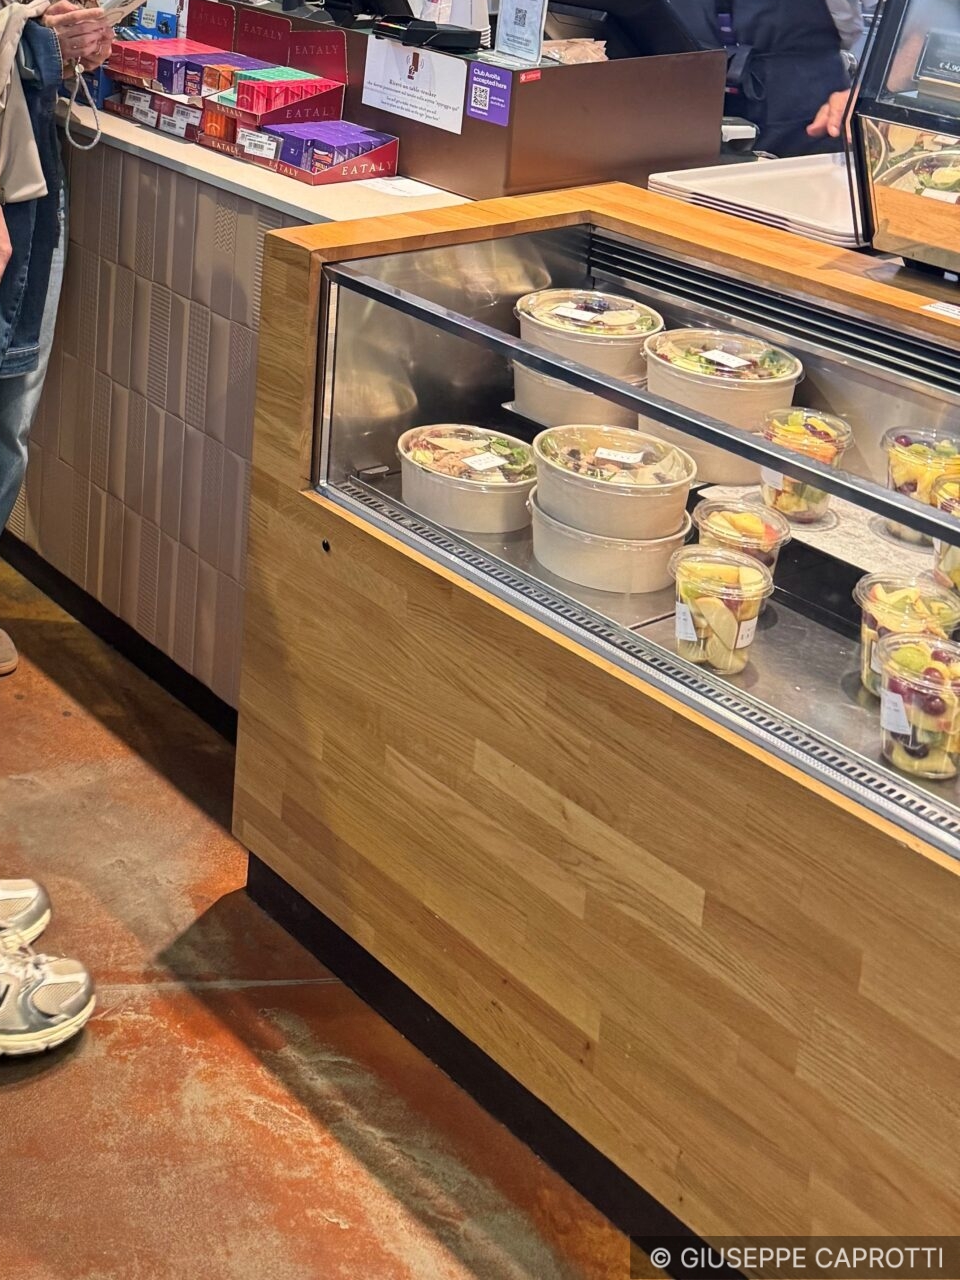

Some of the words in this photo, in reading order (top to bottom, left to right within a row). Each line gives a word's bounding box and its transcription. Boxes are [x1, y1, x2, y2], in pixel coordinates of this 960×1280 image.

[243, 23, 284, 41] EATALY
[295, 44, 339, 54] EATALY
[473, 68, 486, 76] Club
[472, 76, 496, 87] accepted
[495, 81, 507, 90] here
[216, 104, 243, 118] EATALY
[285, 105, 337, 119] EATALY
[211, 140, 240, 156] EATALY
[268, 160, 299, 177] EATALY
[342, 160, 395, 176] EATALY
